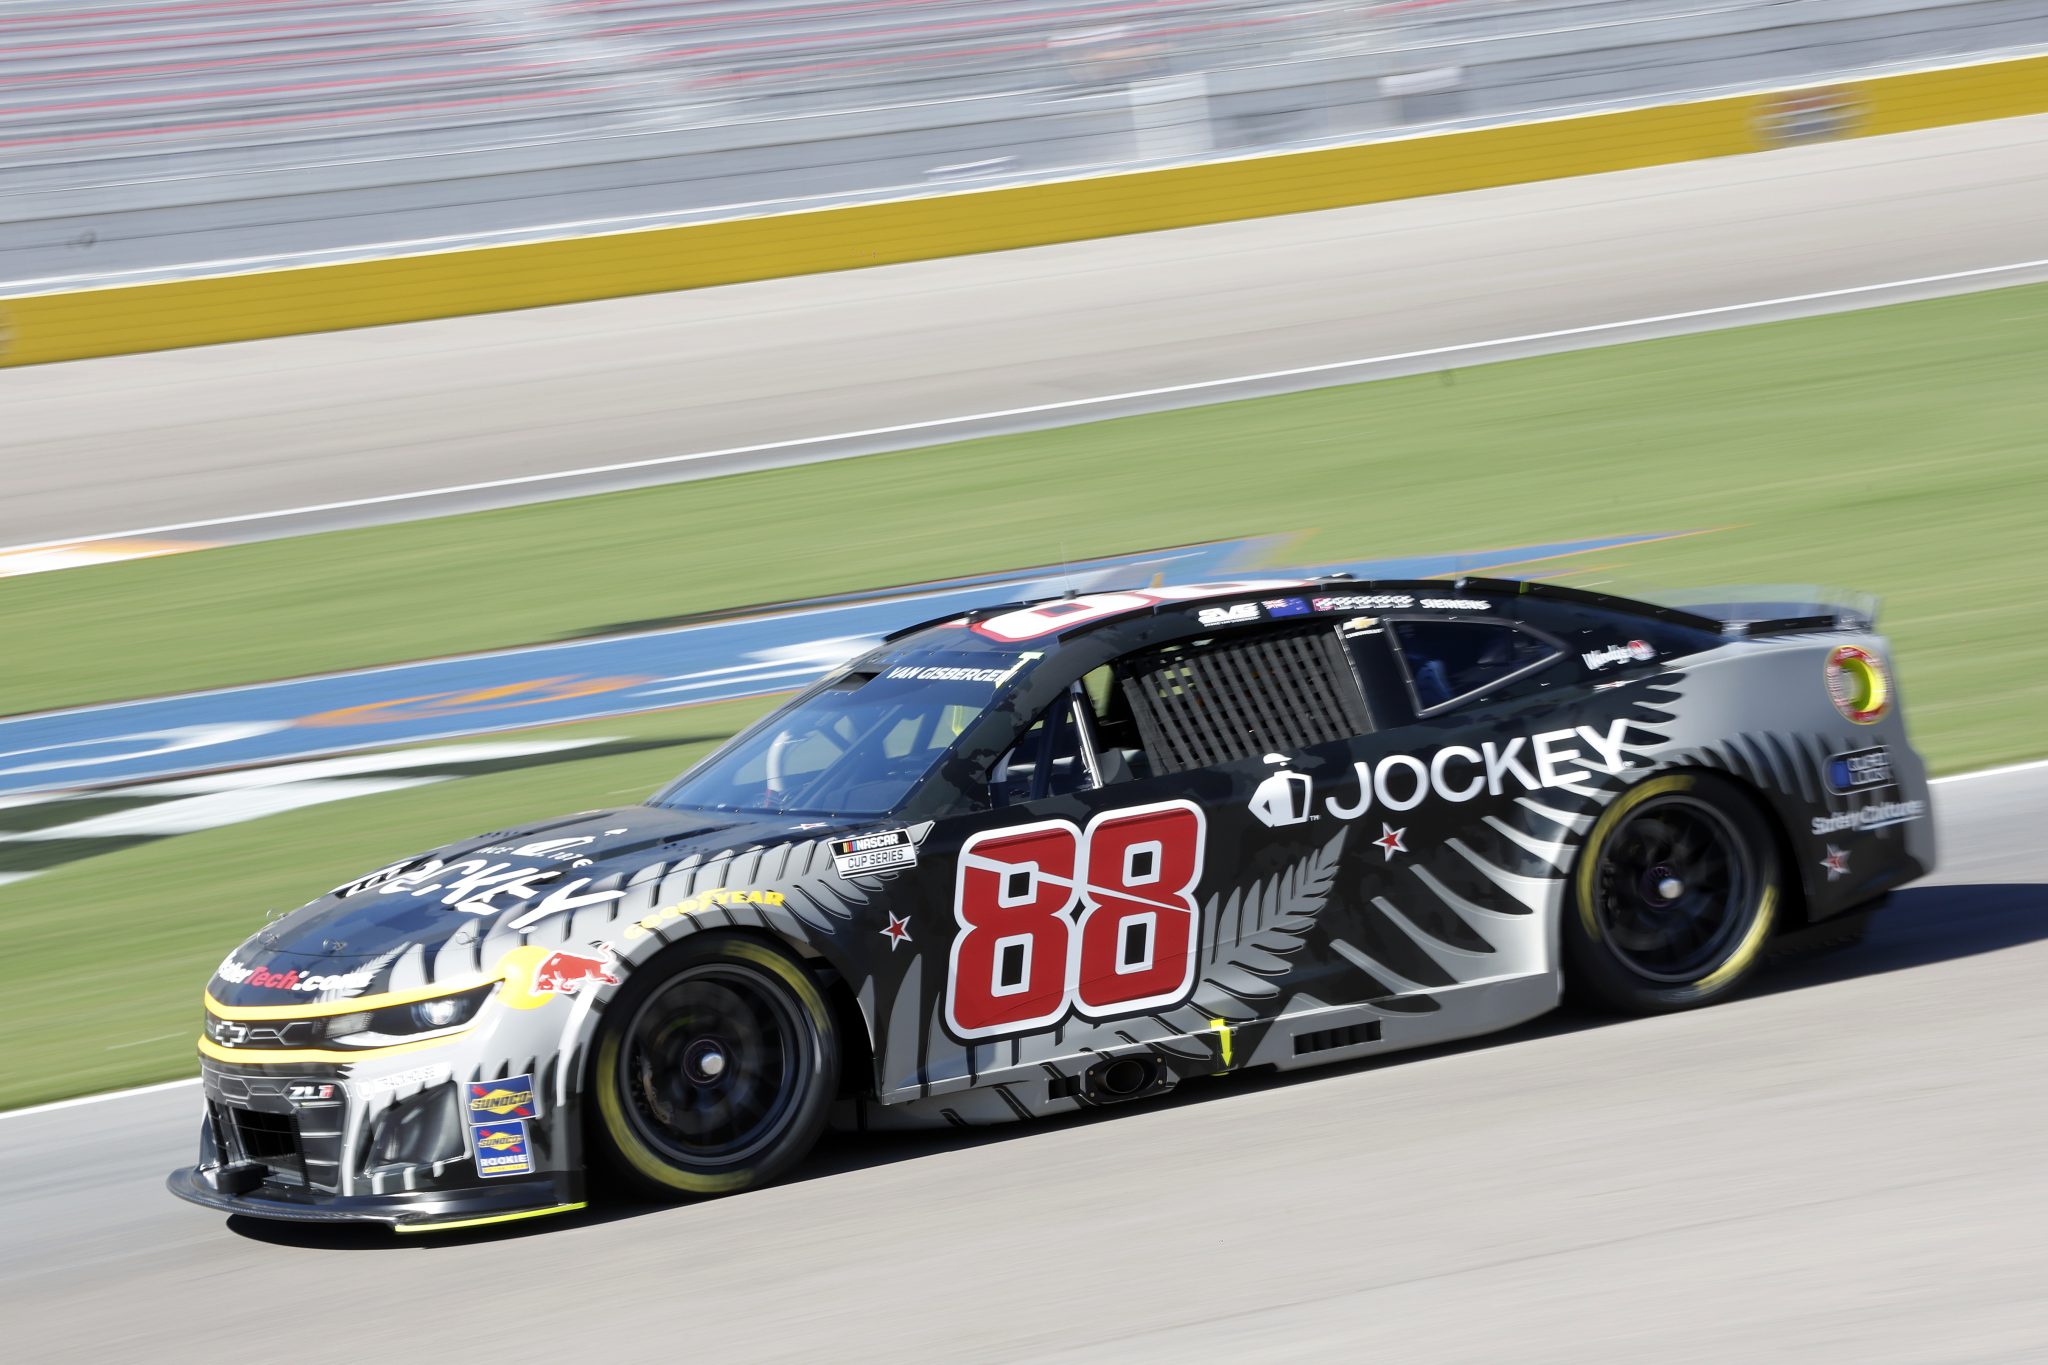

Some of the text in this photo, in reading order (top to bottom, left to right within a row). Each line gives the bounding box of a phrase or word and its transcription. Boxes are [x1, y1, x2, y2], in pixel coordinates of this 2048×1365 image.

[1419, 599, 1492, 611] SIEMENS
[886, 666, 926, 680] VAN
[1325, 718, 1628, 820] JOCKEY
[855, 833, 899, 851] NASCAR
[848, 849, 904, 869] CUP SERIES
[945, 799, 1207, 1040] 88
[470, 1090, 533, 1111] SUNOCO
[478, 1134, 524, 1149] SUNOCO
[480, 1154, 528, 1167] ROOKIE
